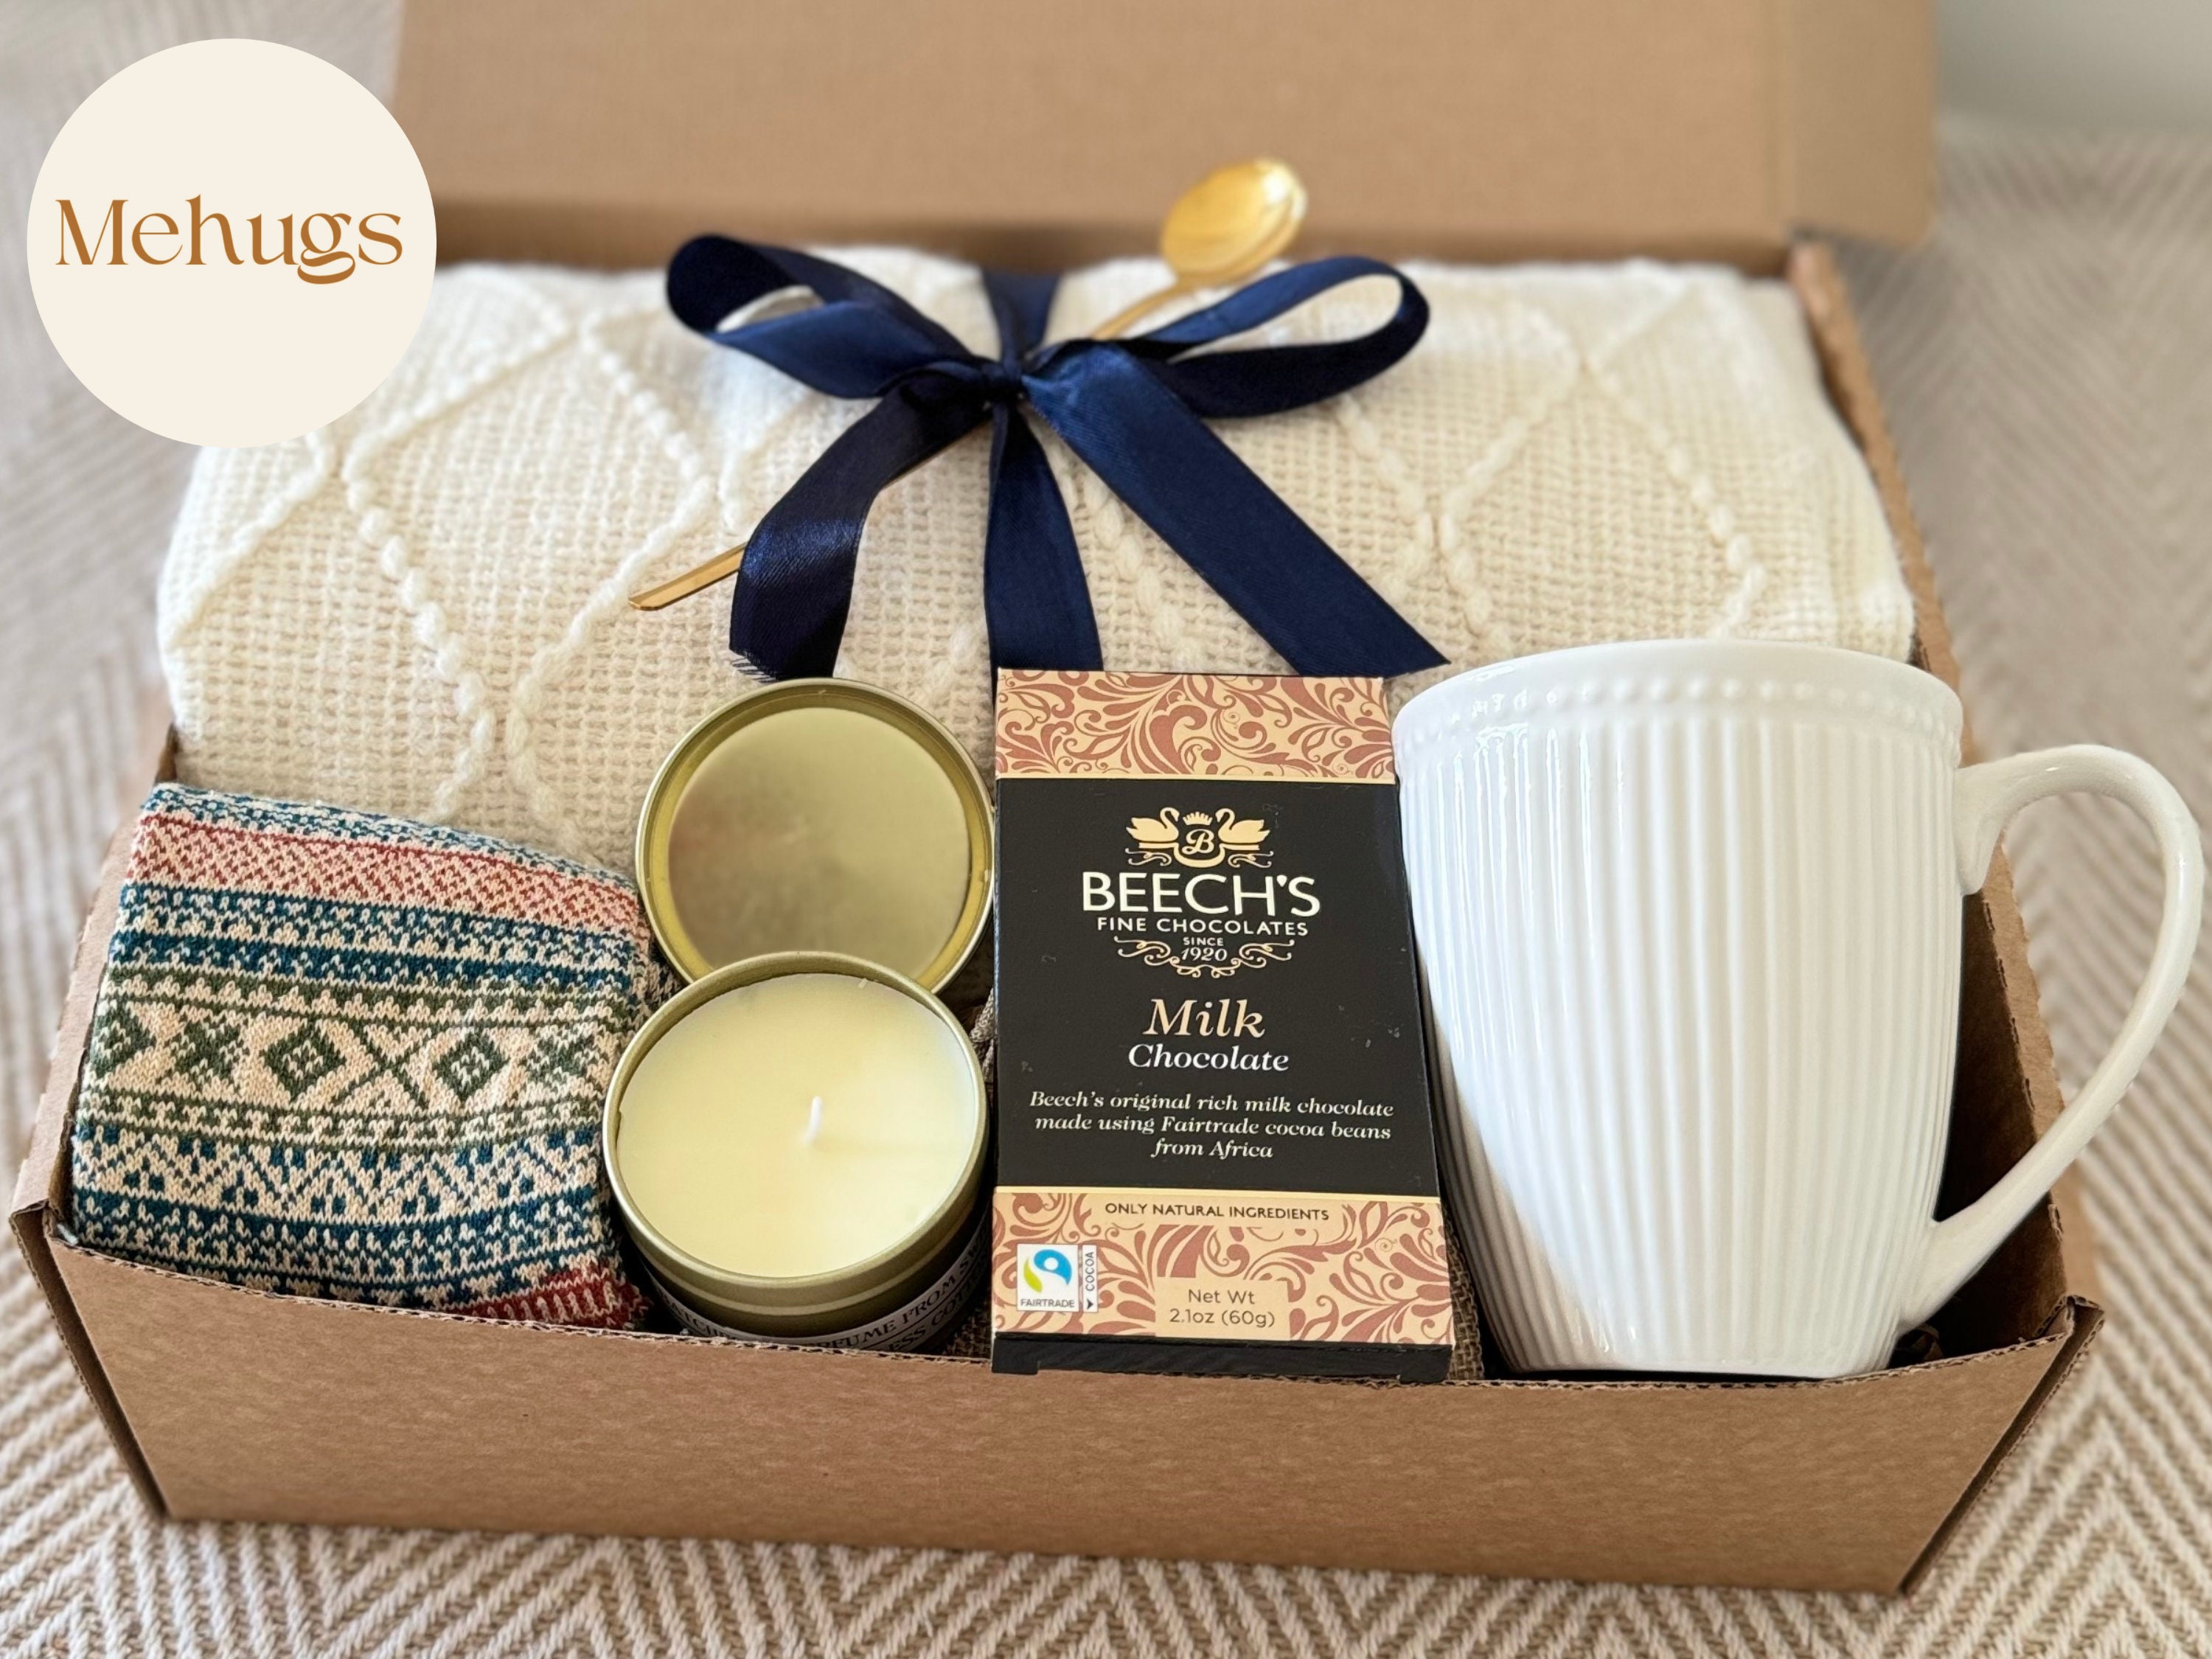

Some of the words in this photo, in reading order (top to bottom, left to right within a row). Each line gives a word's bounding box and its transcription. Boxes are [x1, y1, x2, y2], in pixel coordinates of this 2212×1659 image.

[1181, 828, 1215, 855] B
[1082, 871, 1321, 917] BEECH'S
[1097, 917, 1147, 932] FINE
[1155, 919, 1310, 937] CHOCOLATES
[1183, 936, 1224, 947] SINCE
[1180, 947, 1228, 962] 1920
[1142, 998, 1266, 1038] Milk
[1128, 1043, 1289, 1071] Chocolate
[1110, 1093, 1192, 1112] original
[1197, 1094, 1239, 1111] rich
[1245, 1096, 1291, 1113] milk
[1297, 1099, 1394, 1117] chocolate
[1035, 1113, 1093, 1130] made
[1098, 1116, 1155, 1135] using
[1161, 1116, 1259, 1135] Fairtrade
[1265, 1124, 1325, 1137] cocoa
[1331, 1121, 1391, 1139] beans
[1150, 1137, 1204, 1158] from
[1208, 1139, 1273, 1160] Africa
[1105, 1203, 1148, 1214] ONLY
[1152, 1203, 1225, 1217] NATURAL
[1229, 1206, 1329, 1221] INGREDIENTS
[1085, 1251, 1096, 1292] COCOA
[902, 1275, 956, 1324] FROM
[1020, 1298, 1075, 1308] FAIRTRADE
[1188, 1288, 1221, 1304] Net
[1229, 1290, 1256, 1305] Wt
[1169, 1308, 1215, 1324] 2.1oz
[1221, 1310, 1276, 1329] (60g)
